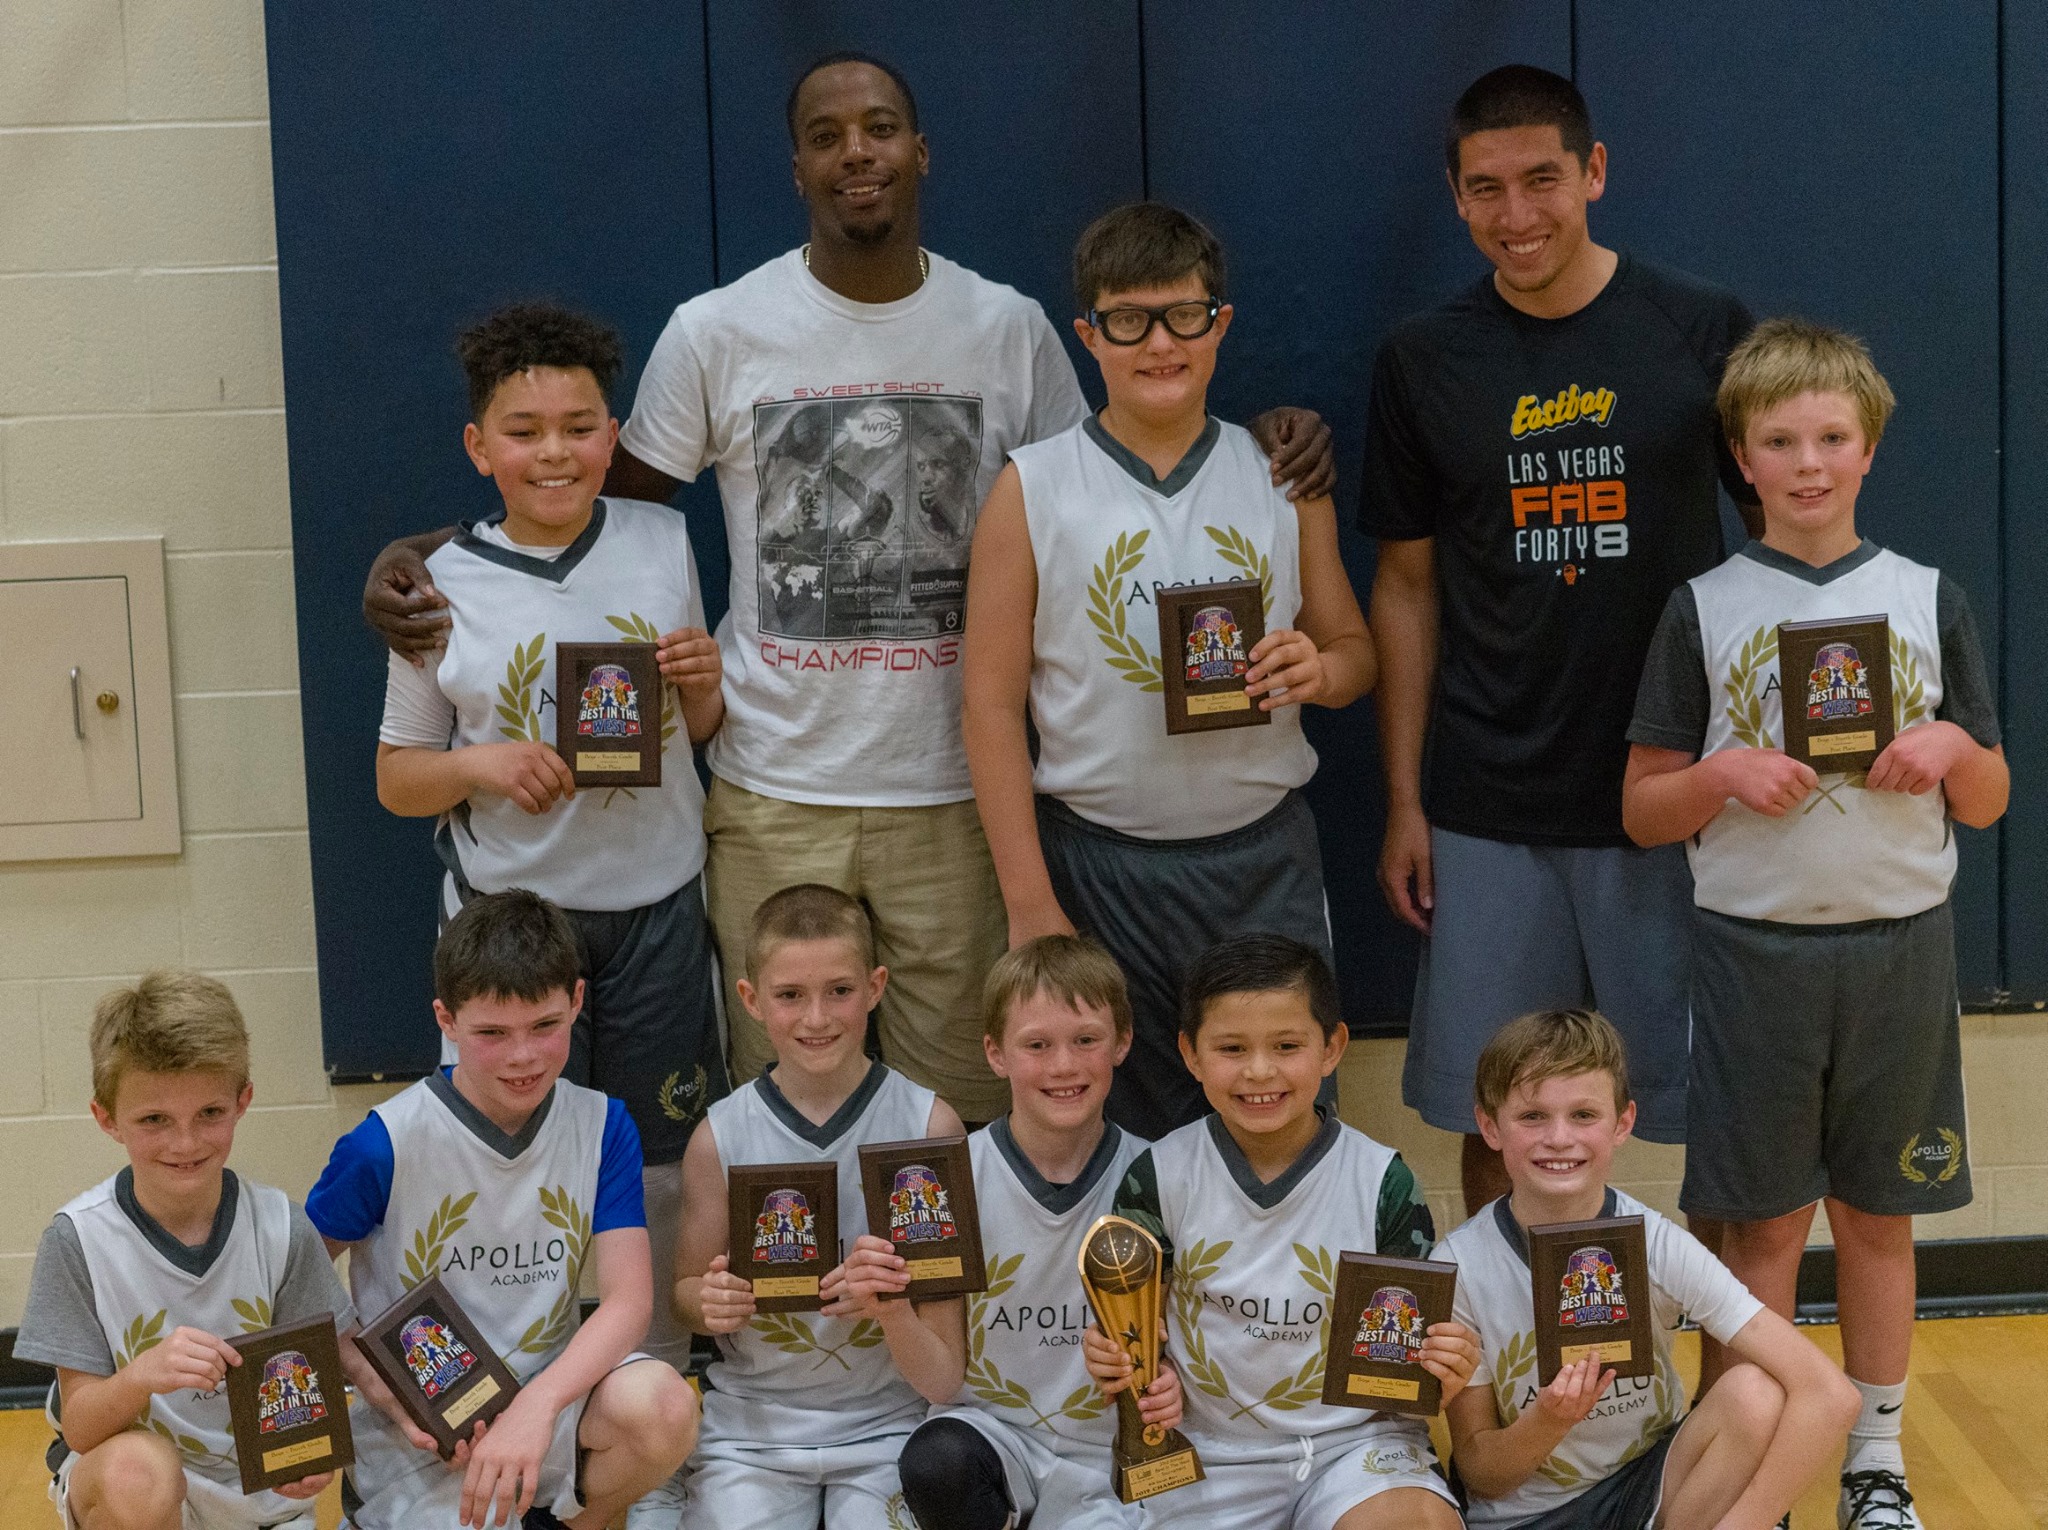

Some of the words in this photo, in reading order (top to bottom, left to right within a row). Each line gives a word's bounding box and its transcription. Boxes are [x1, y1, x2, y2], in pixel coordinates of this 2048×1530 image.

[1510, 384, 1616, 439] Eastbay
[1507, 452, 1547, 484] LAS
[1558, 445, 1625, 479] VEGAS
[1511, 479, 1627, 528] FAB
[1516, 526, 1588, 562] FORTY
[760, 642, 959, 672] CHAMPIONS
[1187, 650, 1211, 666] BEST
[1213, 648, 1224, 660] IN
[1226, 649, 1245, 660] THE
[1200, 660, 1234, 677] WEST
[1809, 688, 1834, 705] BEST
[1836, 687, 1847, 699] IN
[1850, 687, 1870, 699] THE
[580, 707, 605, 721] BEST
[607, 706, 617, 719] IN
[620, 708, 639, 721] THE
[1822, 700, 1858, 716] WEST
[593, 719, 627, 733] WEST
[1910, 1145, 1952, 1160] APOLLO
[892, 1211, 916, 1227] BEST
[918, 1210, 930, 1222] IN
[931, 1210, 953, 1222] THE
[755, 1233, 780, 1247] BEST
[783, 1232, 794, 1244] IN
[796, 1232, 816, 1245] THE
[905, 1223, 941, 1239] WEST
[443, 1238, 566, 1272] APOLLO
[768, 1244, 803, 1259] WEST
[491, 1269, 560, 1287] ACADEMY
[1202, 1291, 1323, 1326] APOLLO
[1561, 1293, 1587, 1311] BEST
[1590, 1292, 1602, 1305] IN
[1604, 1292, 1626, 1305] THE
[988, 1304, 1088, 1332] APOLL
[1575, 1306, 1612, 1322] WEST
[1038, 1334, 1085, 1347] ACAD
[1243, 1323, 1314, 1342] ACADEMY
[1357, 1330, 1385, 1342] BEST
[1387, 1331, 1399, 1344] IN
[1402, 1334, 1421, 1349] THE
[1369, 1343, 1407, 1360] WEST
[418, 1361, 438, 1386] BEST
[435, 1353, 449, 1367] IN
[445, 1343, 467, 1358] THE
[433, 1359, 465, 1388] WEST
[261, 1398, 285, 1419] BEST
[288, 1394, 300, 1408] IN
[302, 1392, 323, 1405] THE
[1582, 1395, 1648, 1421] CADEMY
[275, 1406, 312, 1428] WEST
